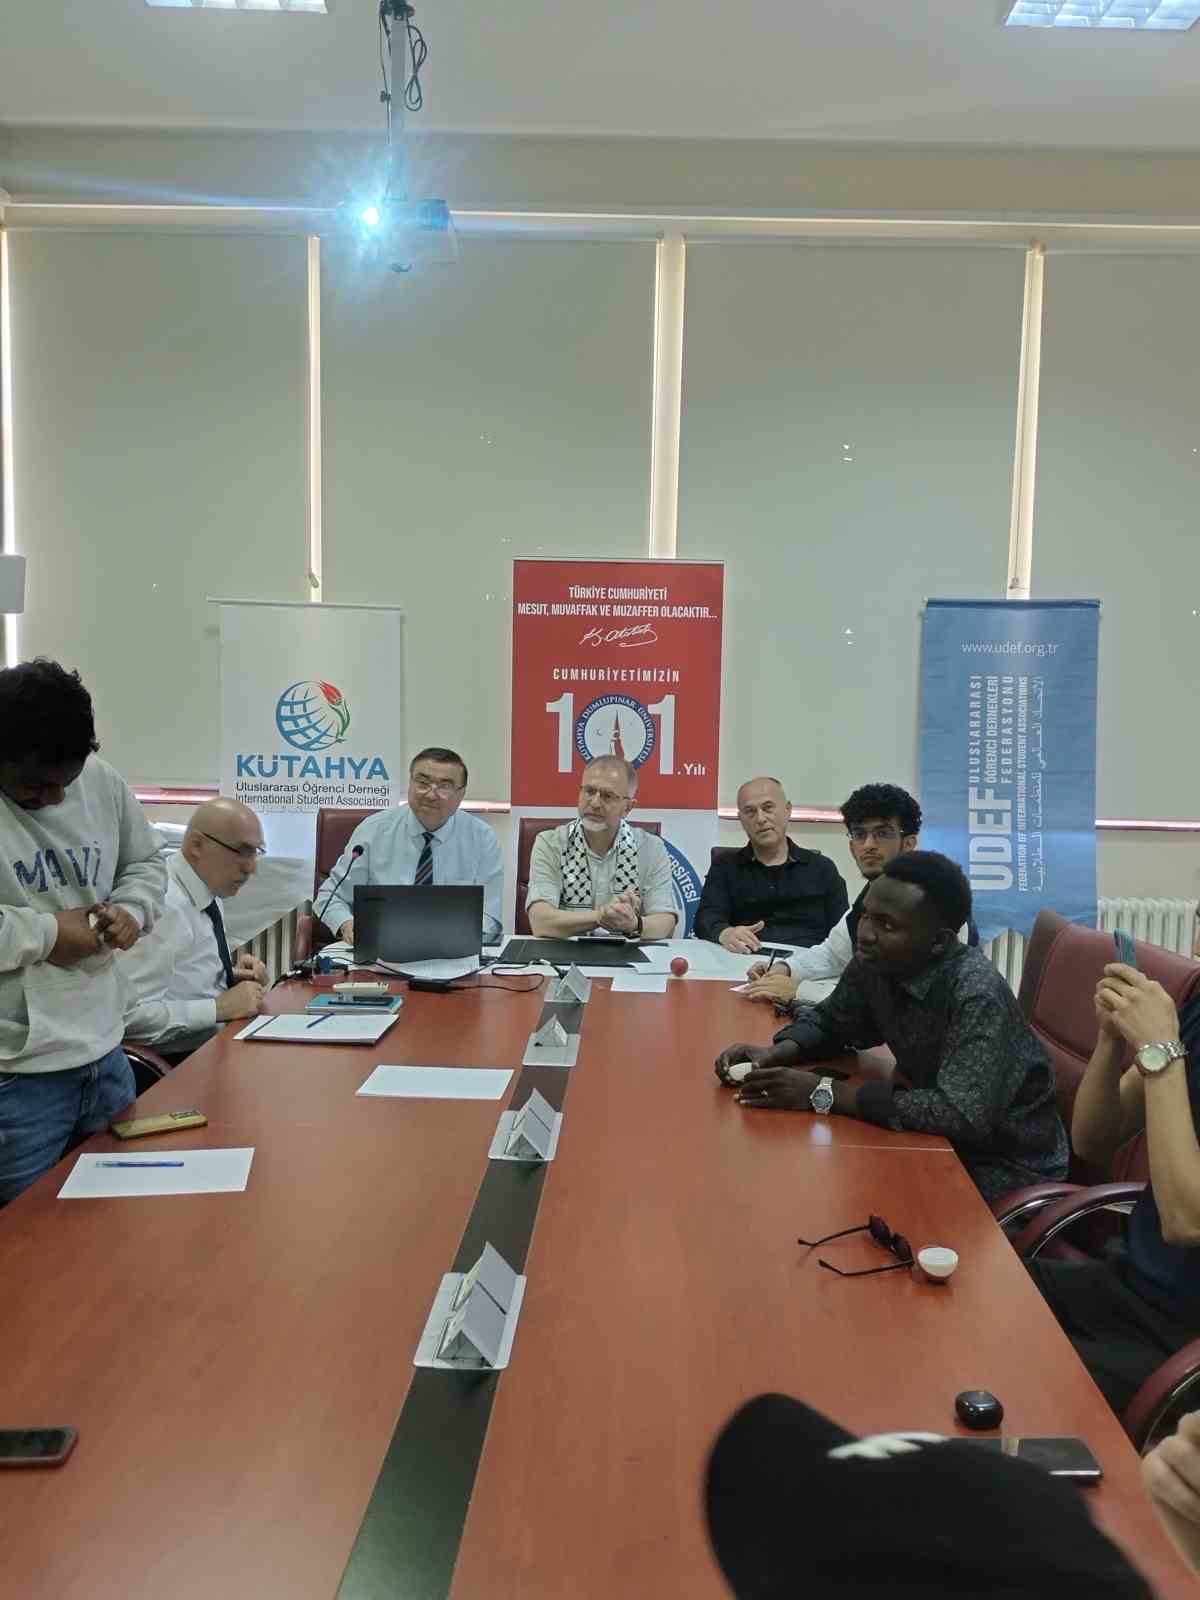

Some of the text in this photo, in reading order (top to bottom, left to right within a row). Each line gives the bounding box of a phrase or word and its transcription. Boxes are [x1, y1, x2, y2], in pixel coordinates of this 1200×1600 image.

[568, 585, 667, 600] TÜRKİYE CUMHURİYETİ
[518, 602, 717, 618] MESUT, MUVAFFAK VE MUZAFFER OLACAKTIR...
[961, 641, 1057, 656] www.udef.org.tr
[553, 667, 680, 682] CUMHURİYETİMİZİN
[968, 675, 981, 783] ULUSLARARASI
[984, 676, 998, 784] ÖĞRENCİ DERNEKLERİ
[1001, 676, 1014, 784] FEDERASYONU
[236, 754, 390, 780] KÜTAHYA
[236, 781, 390, 797] Uluslararası Öğrenci Derneği
[1017, 677, 1028, 891] FEDERATION OF INTERNATIONAL STUDENT ASSOCIATIONS
[235, 793, 390, 807] International Student Association
[969, 786, 1013, 890] UDEF
